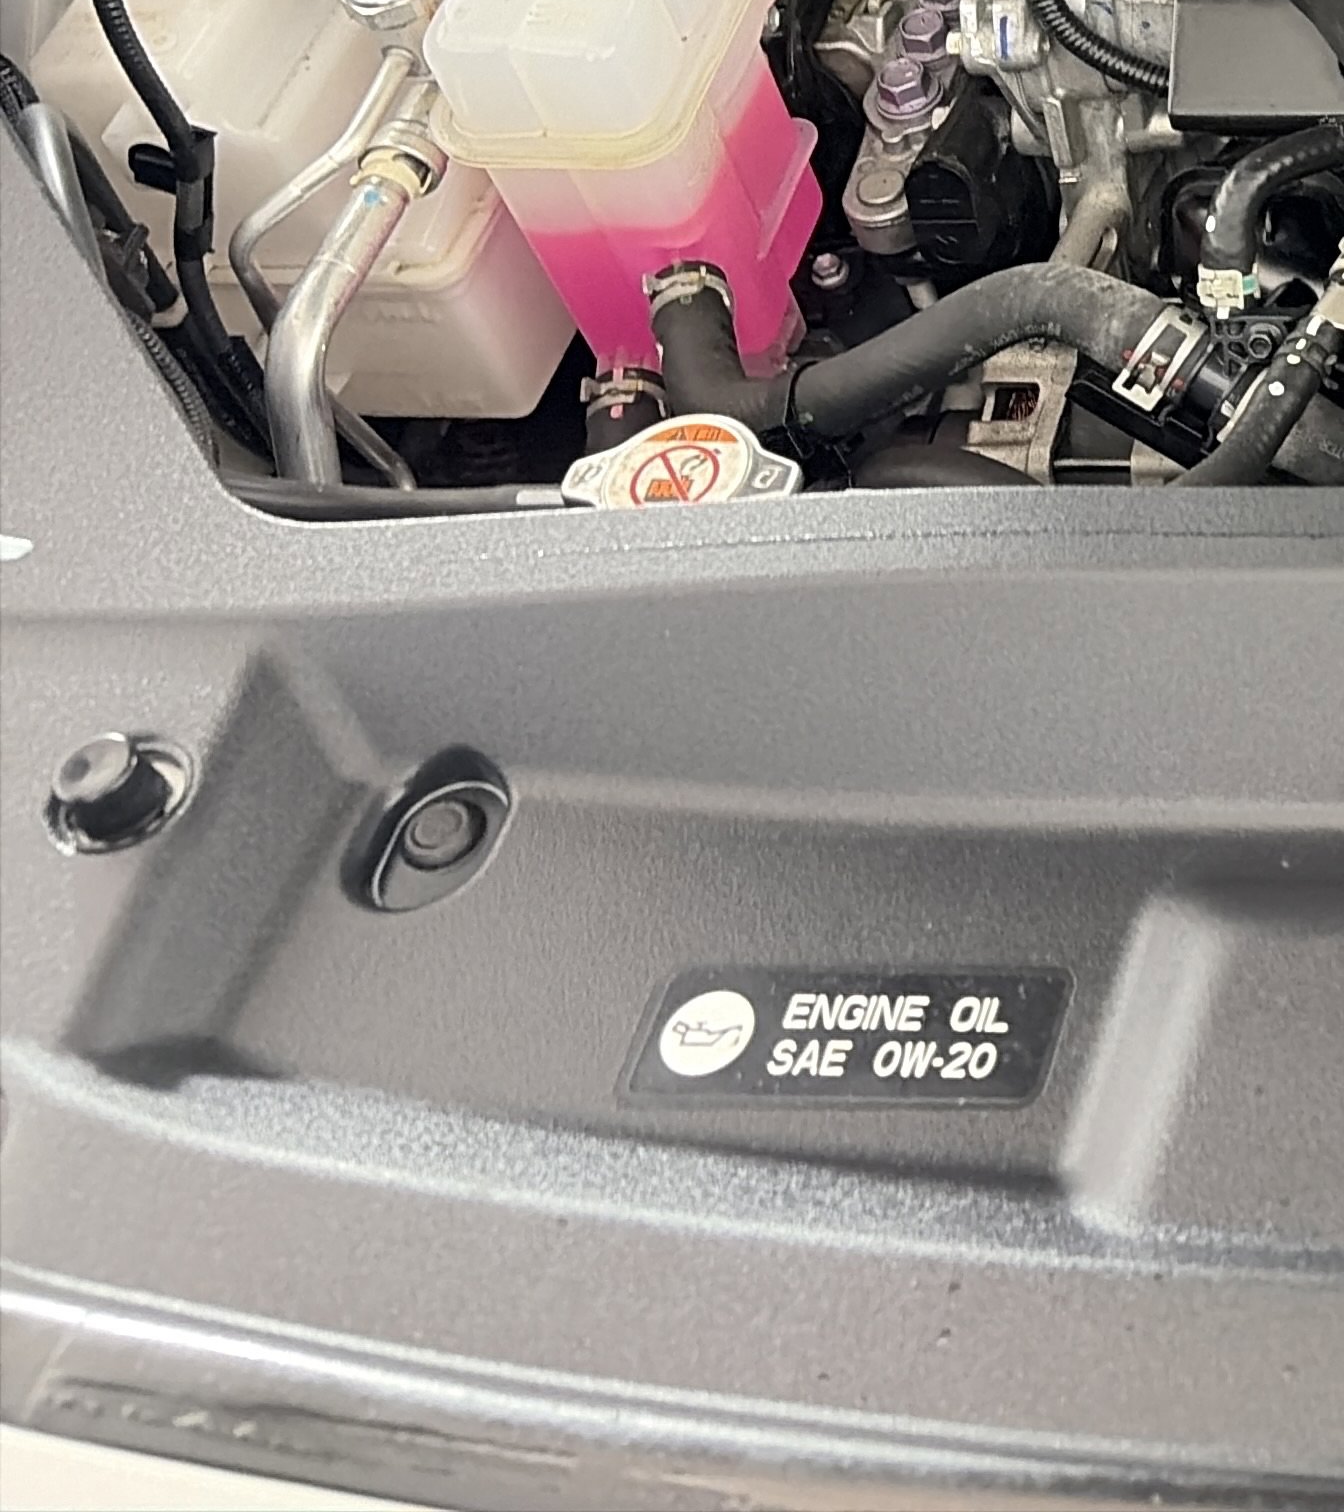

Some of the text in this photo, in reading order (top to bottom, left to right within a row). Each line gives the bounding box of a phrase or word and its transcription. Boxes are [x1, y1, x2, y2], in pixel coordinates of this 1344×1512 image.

[782, 993, 1009, 1034] ENGINE OIL
[766, 1039, 998, 1079] SAE 0W-20
